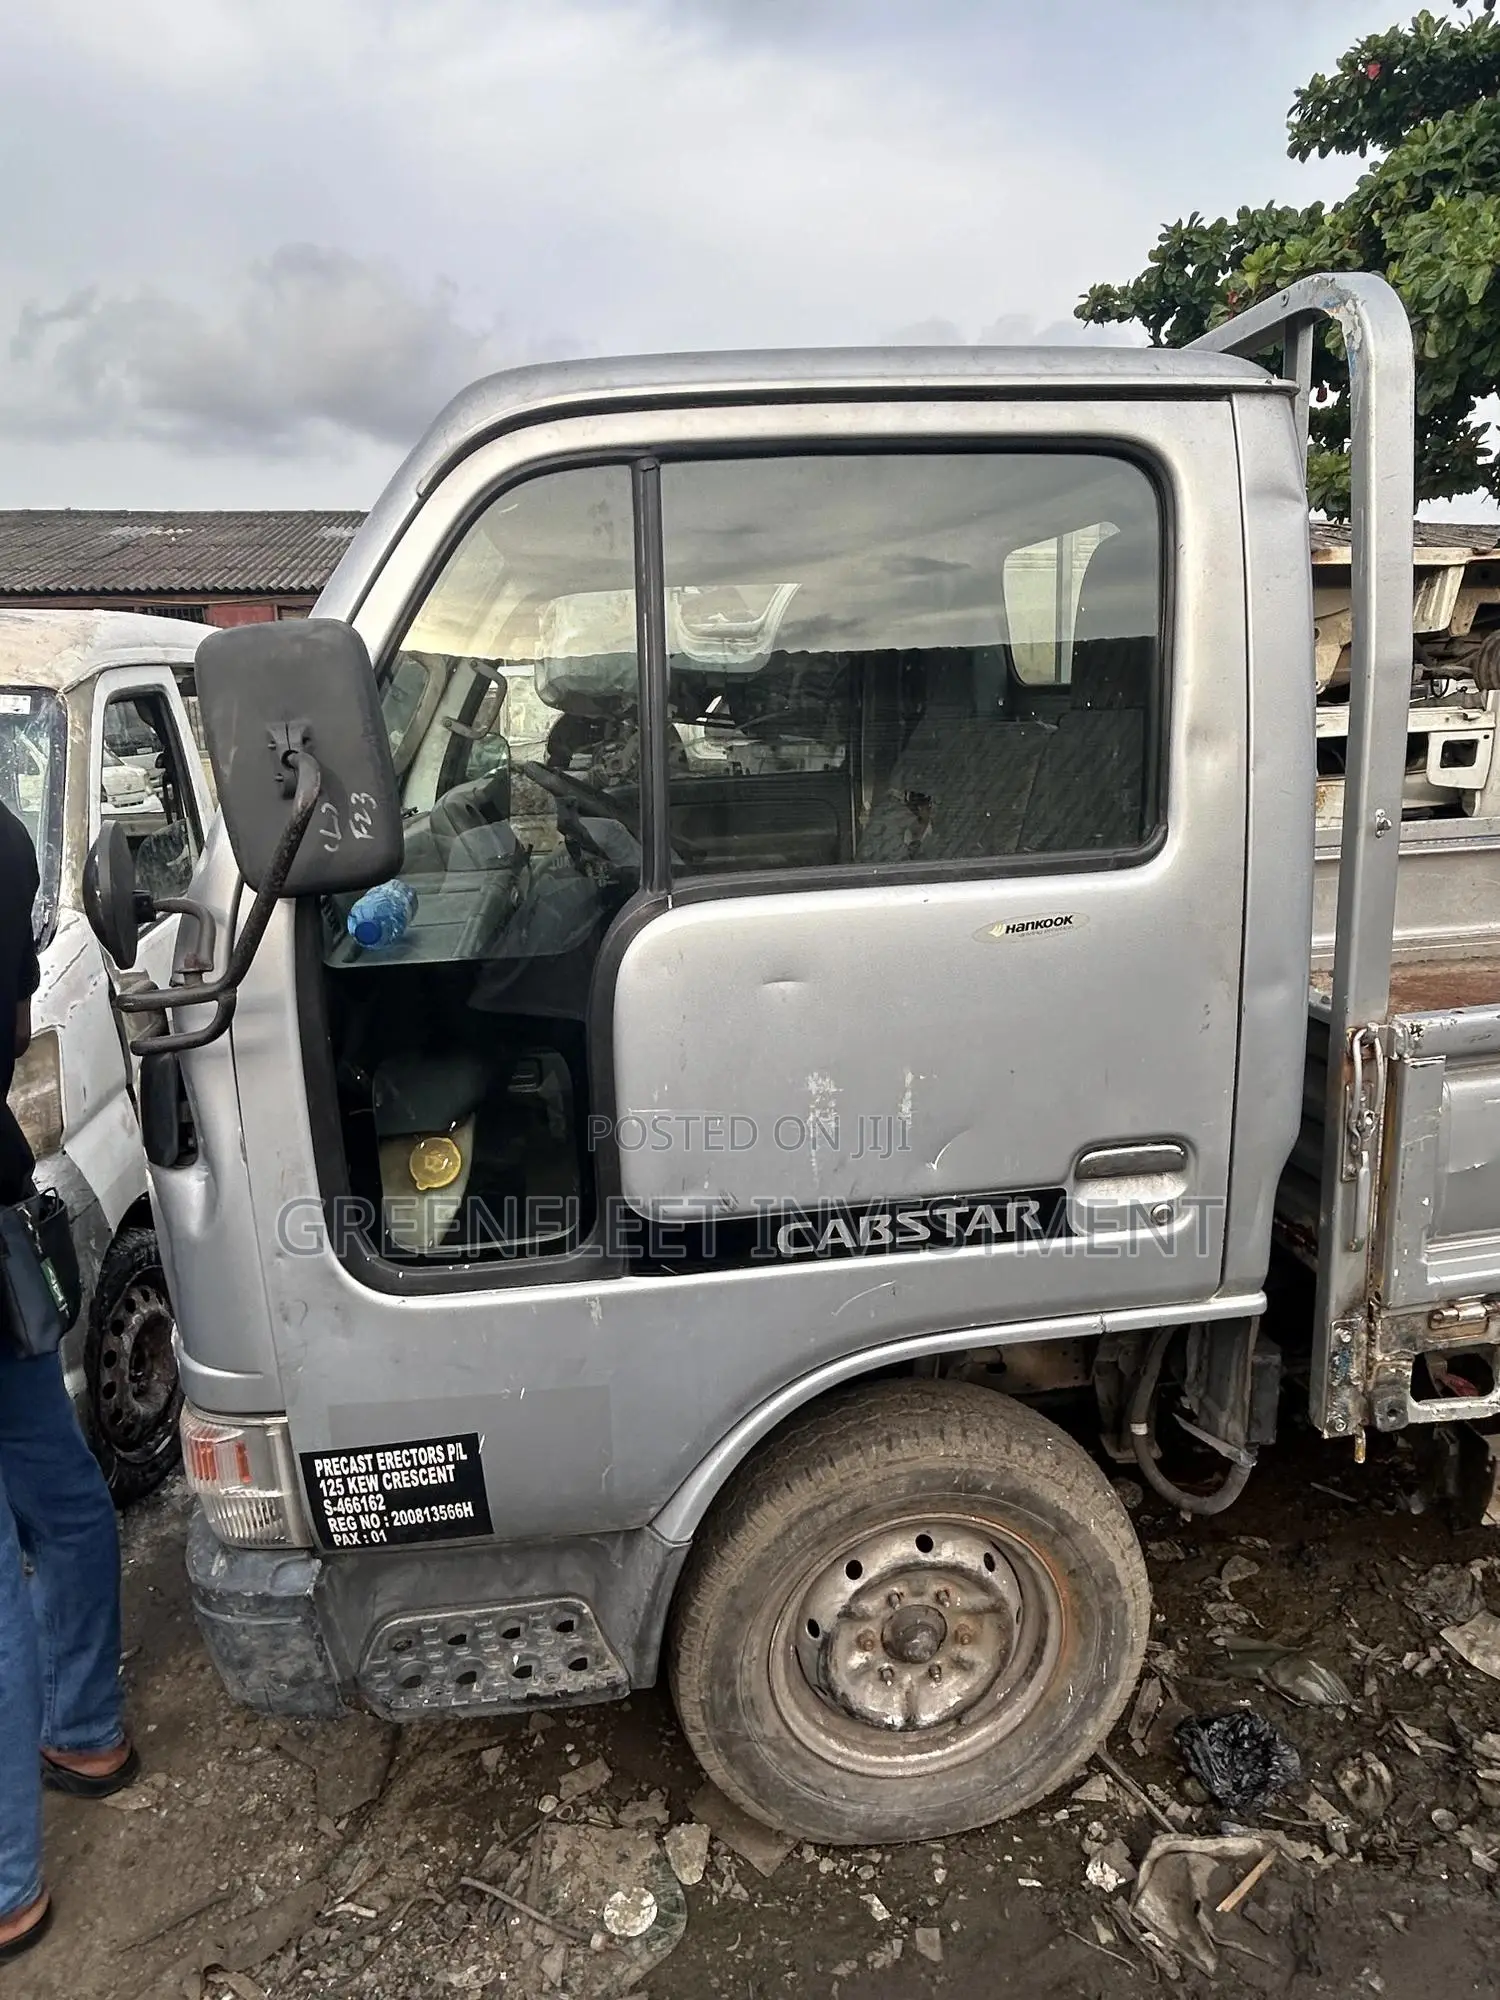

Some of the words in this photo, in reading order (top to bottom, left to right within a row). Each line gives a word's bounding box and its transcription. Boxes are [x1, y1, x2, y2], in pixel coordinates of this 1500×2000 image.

[777, 1199, 1044, 1255] CABSTAR
[314, 1453, 374, 1477] PRECAST
[376, 1443, 446, 1471] ERECTORS
[449, 1442, 468, 1462] P/L
[319, 1478, 345, 1497] 125
[347, 1473, 379, 1494] KEW
[382, 1464, 456, 1490] CRESCENT
[323, 1493, 386, 1516] S-466162
[327, 1516, 358, 1533] REG
[359, 1513, 382, 1530] NO
[392, 1501, 475, 1527] 200813566H
[333, 1532, 360, 1547] PAX
[371, 1529, 388, 1543] 01
